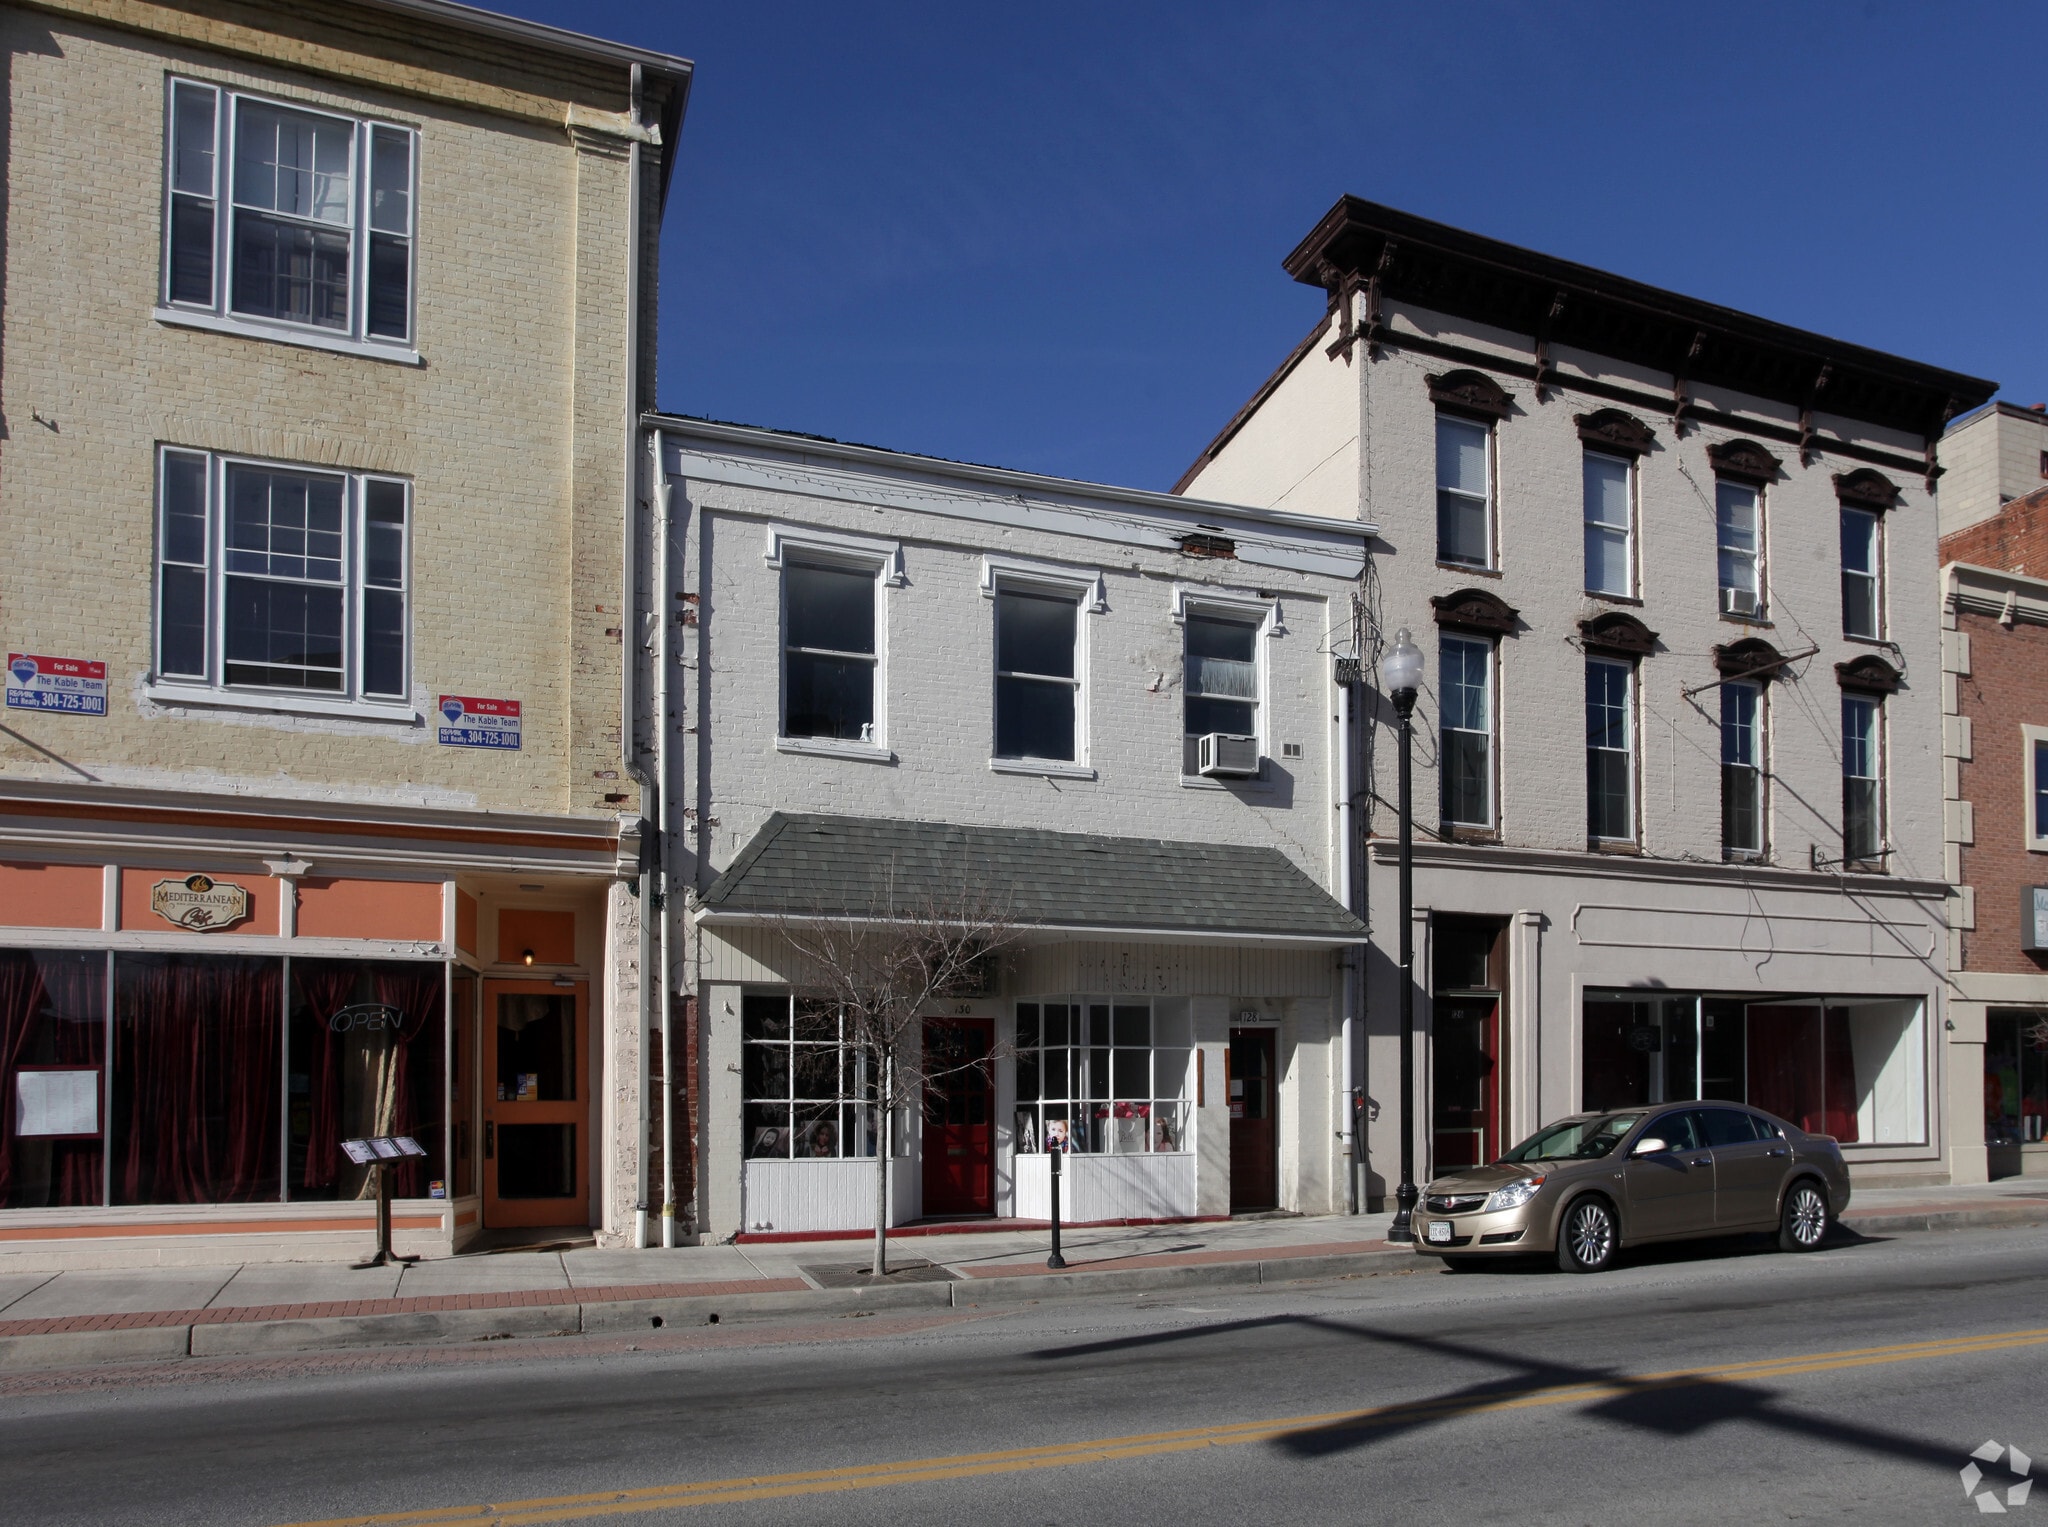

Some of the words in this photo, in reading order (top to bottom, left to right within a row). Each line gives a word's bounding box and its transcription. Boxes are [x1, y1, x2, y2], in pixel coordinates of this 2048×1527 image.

[54, 663, 63, 671] For
[65, 664, 78, 672] Sale
[37, 675, 51, 685] The
[55, 677, 78, 687] Kable
[81, 679, 102, 689] Team
[42, 692, 102, 710] 304-725-1001
[463, 715, 476, 723] The
[478, 716, 498, 725] Kable
[501, 718, 518, 727] Team
[468, 730, 518, 746] 304-725-1001
[157, 891, 241, 905] MEDITERRANEAN
[334, 1011, 403, 1032] OPEN
[1243, 1012, 1258, 1023] 128
